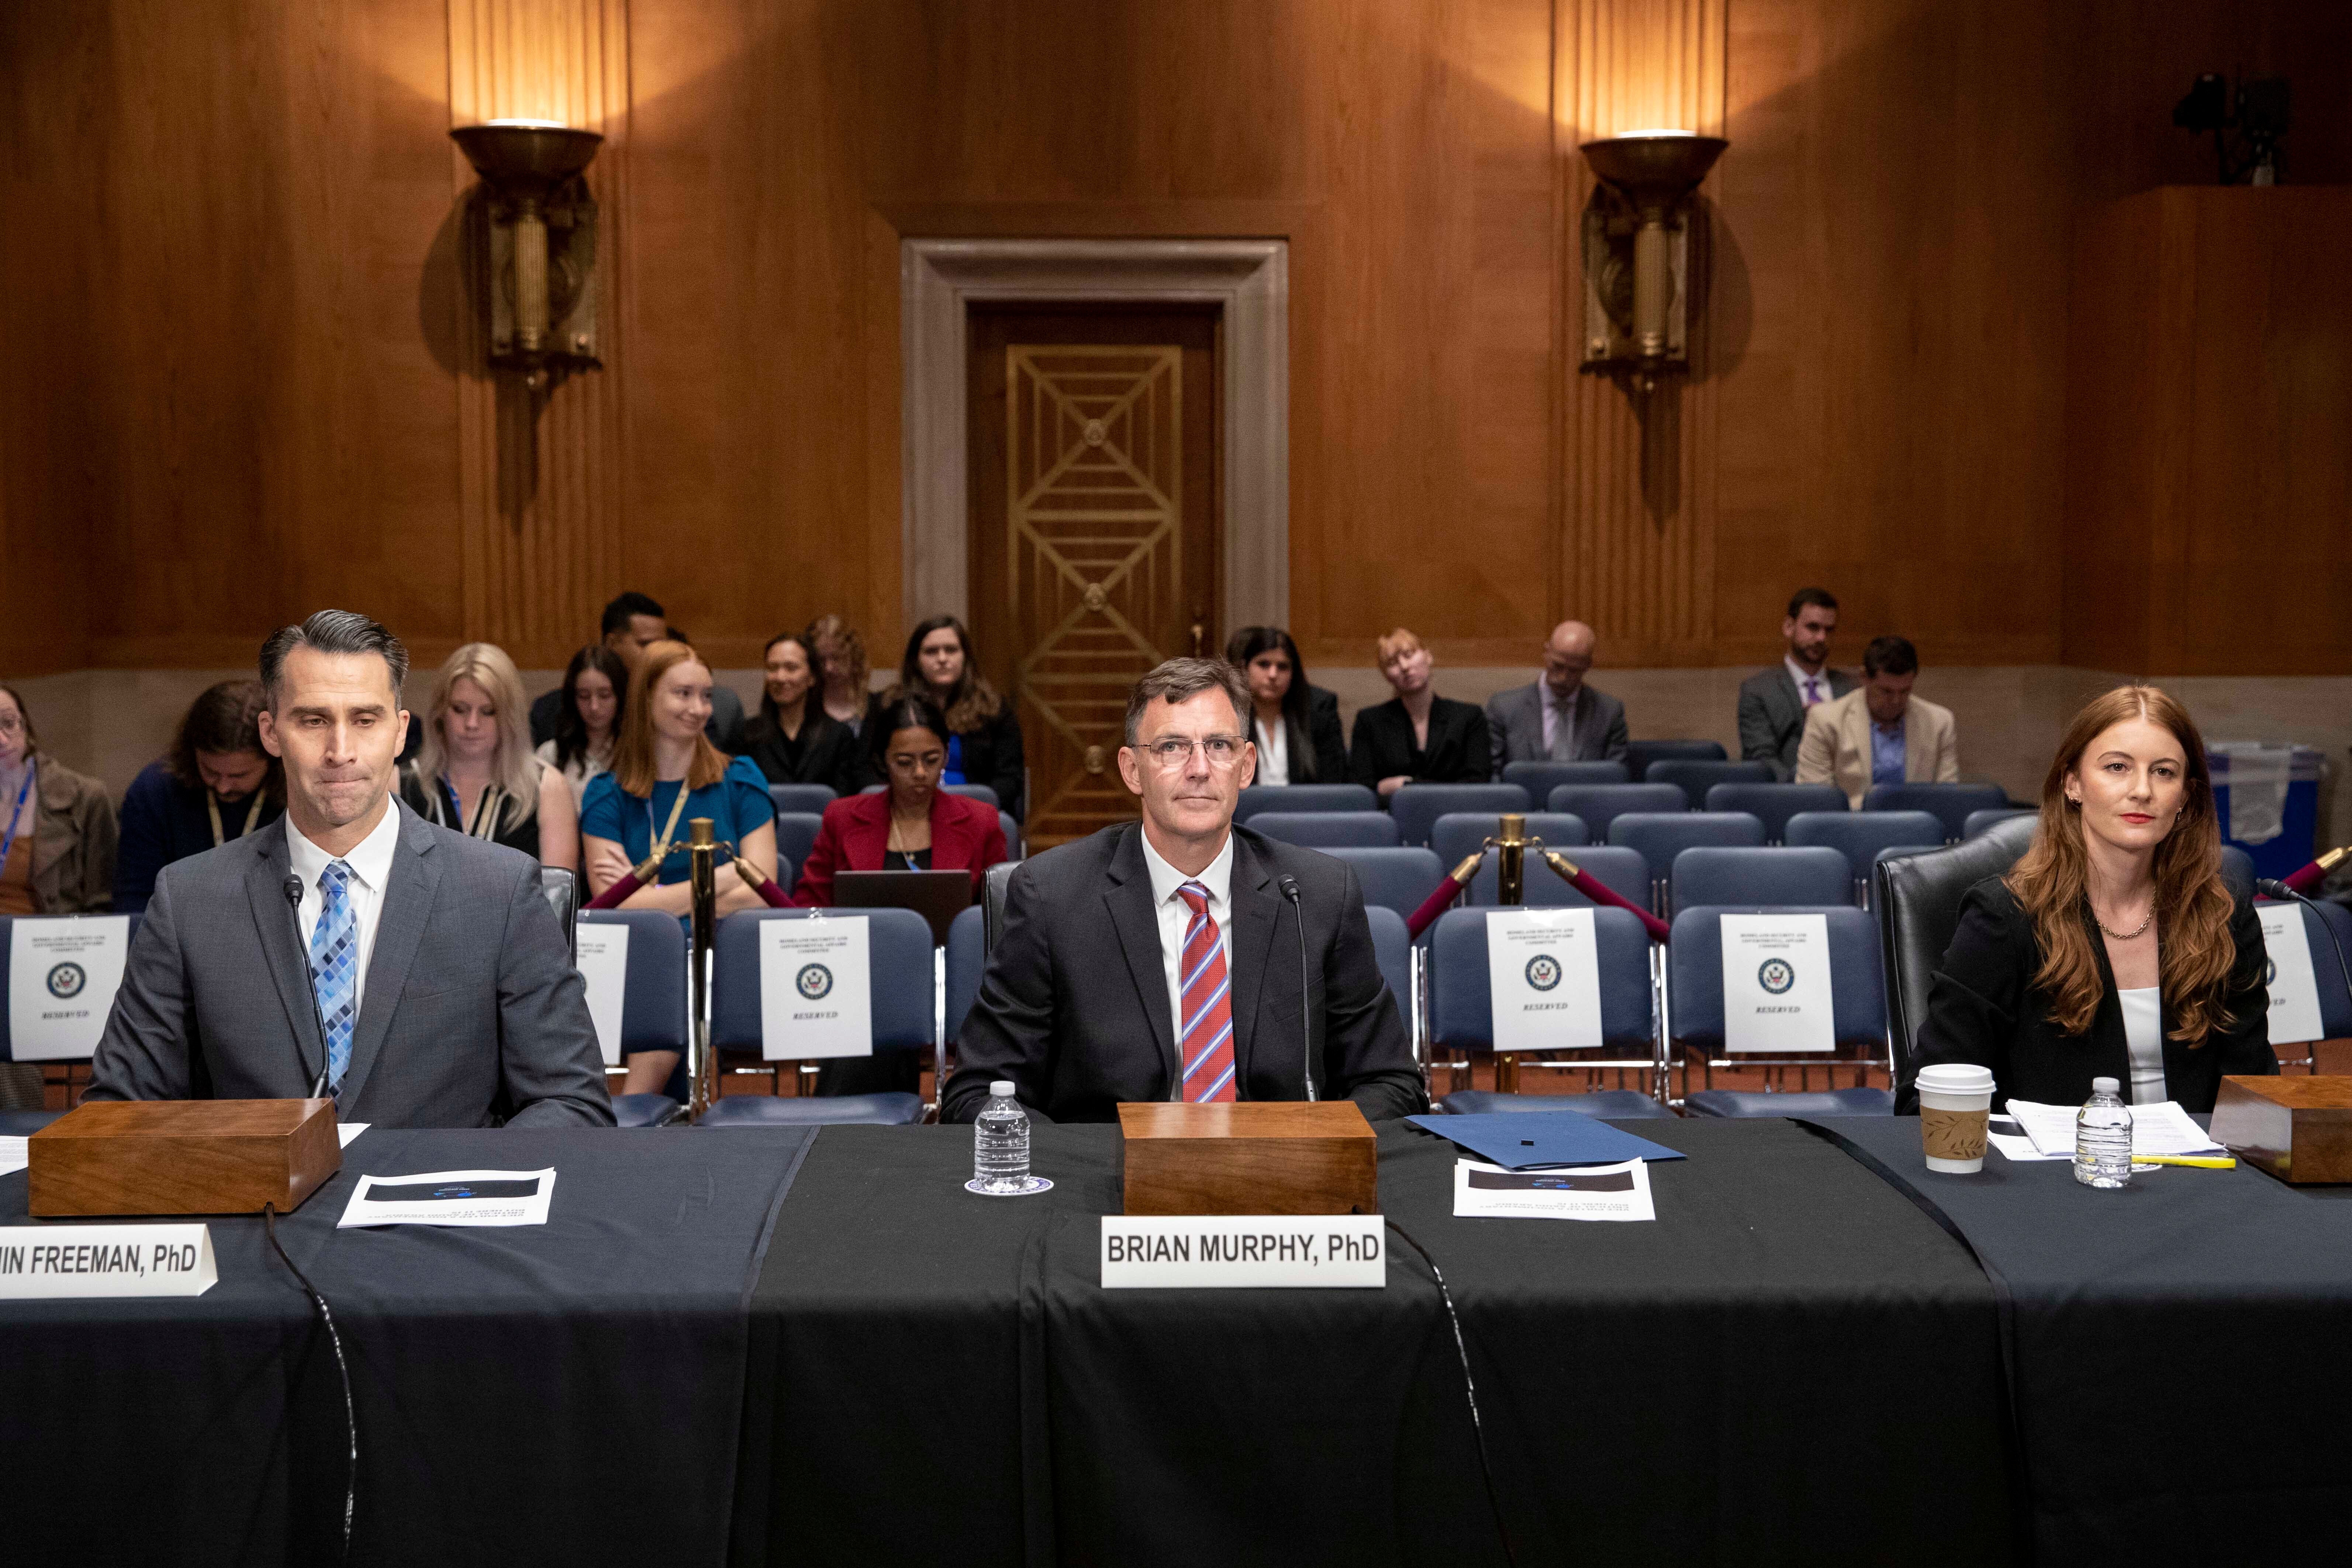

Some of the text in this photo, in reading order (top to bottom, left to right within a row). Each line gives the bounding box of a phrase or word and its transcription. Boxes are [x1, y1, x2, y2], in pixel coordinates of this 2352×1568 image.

[0, 1244, 196, 1278] IN FREEMAN, PhD
[1108, 1234, 1379, 1266] BRIAN MURPHY, PhD
